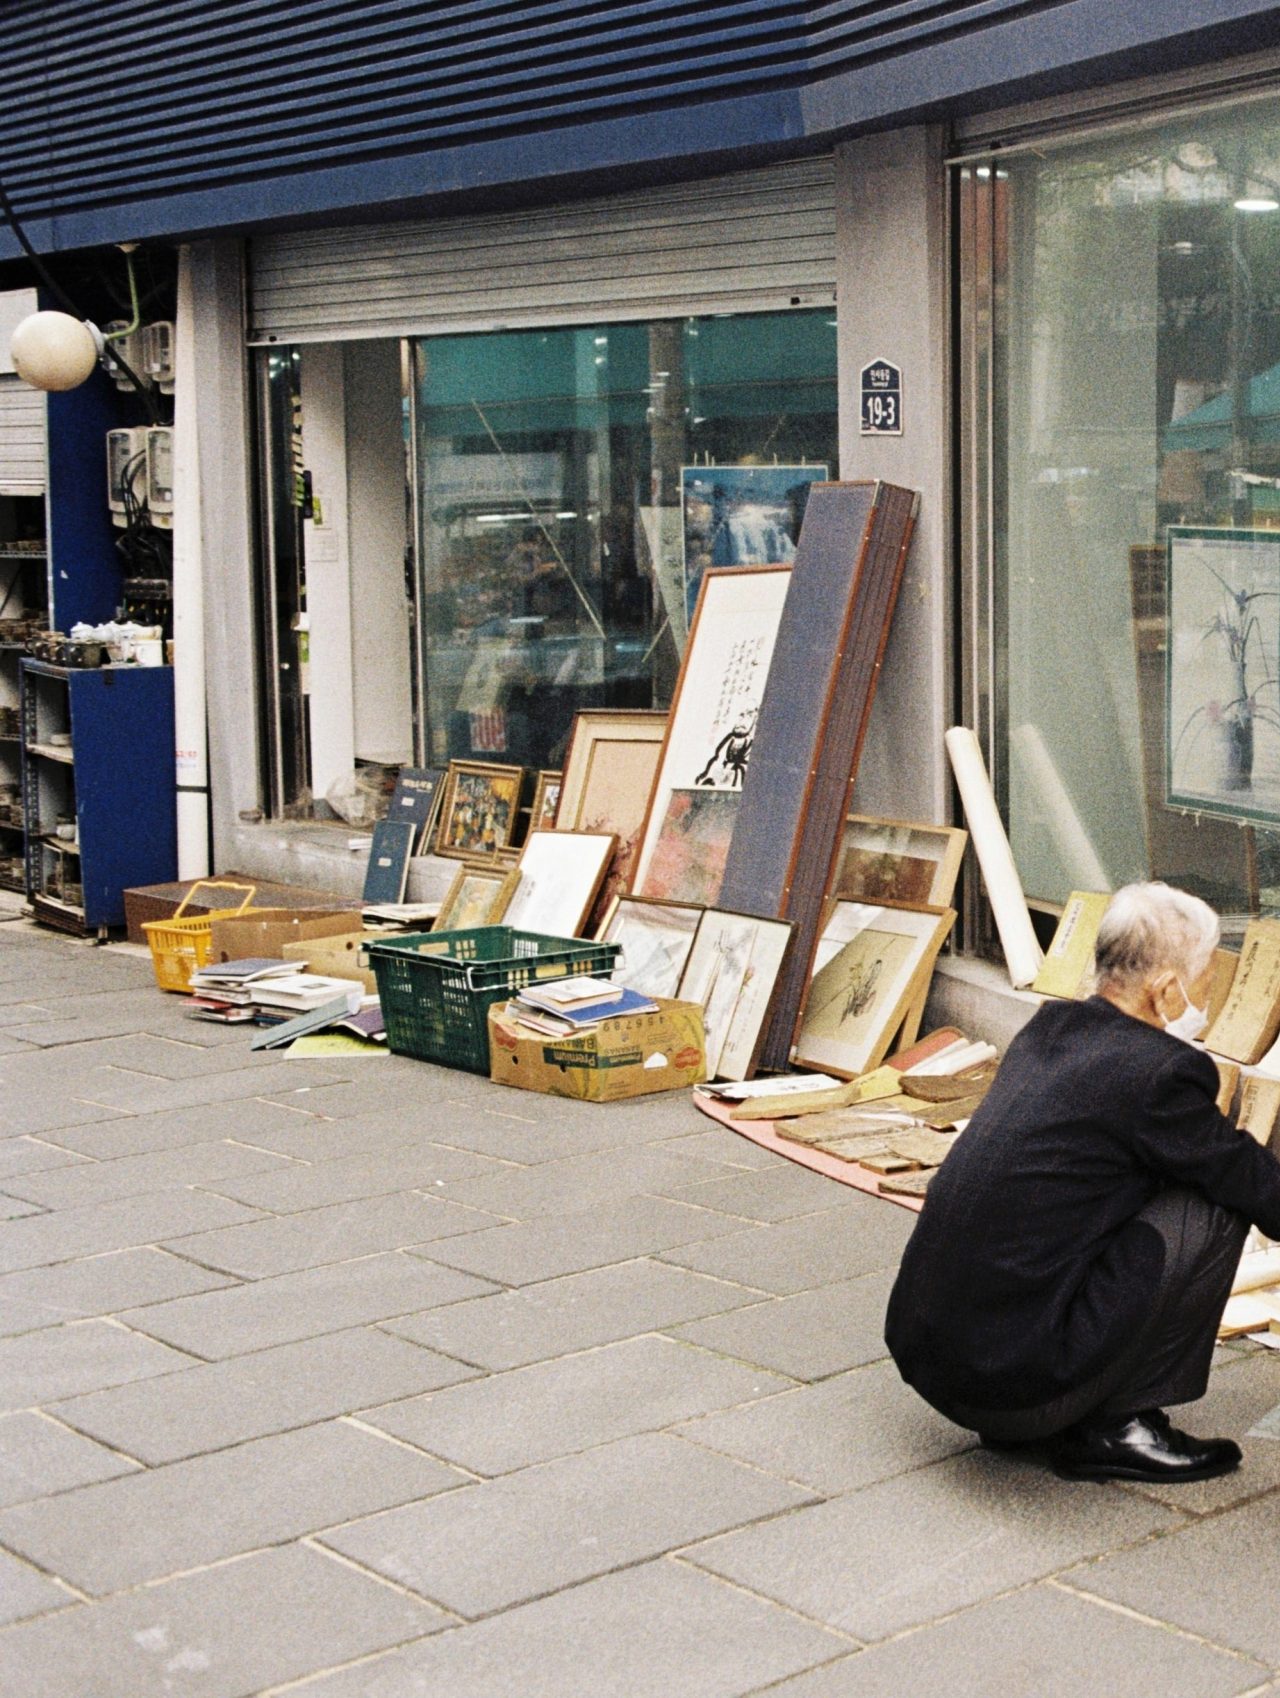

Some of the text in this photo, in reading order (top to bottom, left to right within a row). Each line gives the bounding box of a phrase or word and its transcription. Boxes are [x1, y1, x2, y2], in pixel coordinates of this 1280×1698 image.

[867, 396, 895, 425] 19-3
[554, 1050, 596, 1067] Premium
[609, 1053, 642, 1065] Premium
